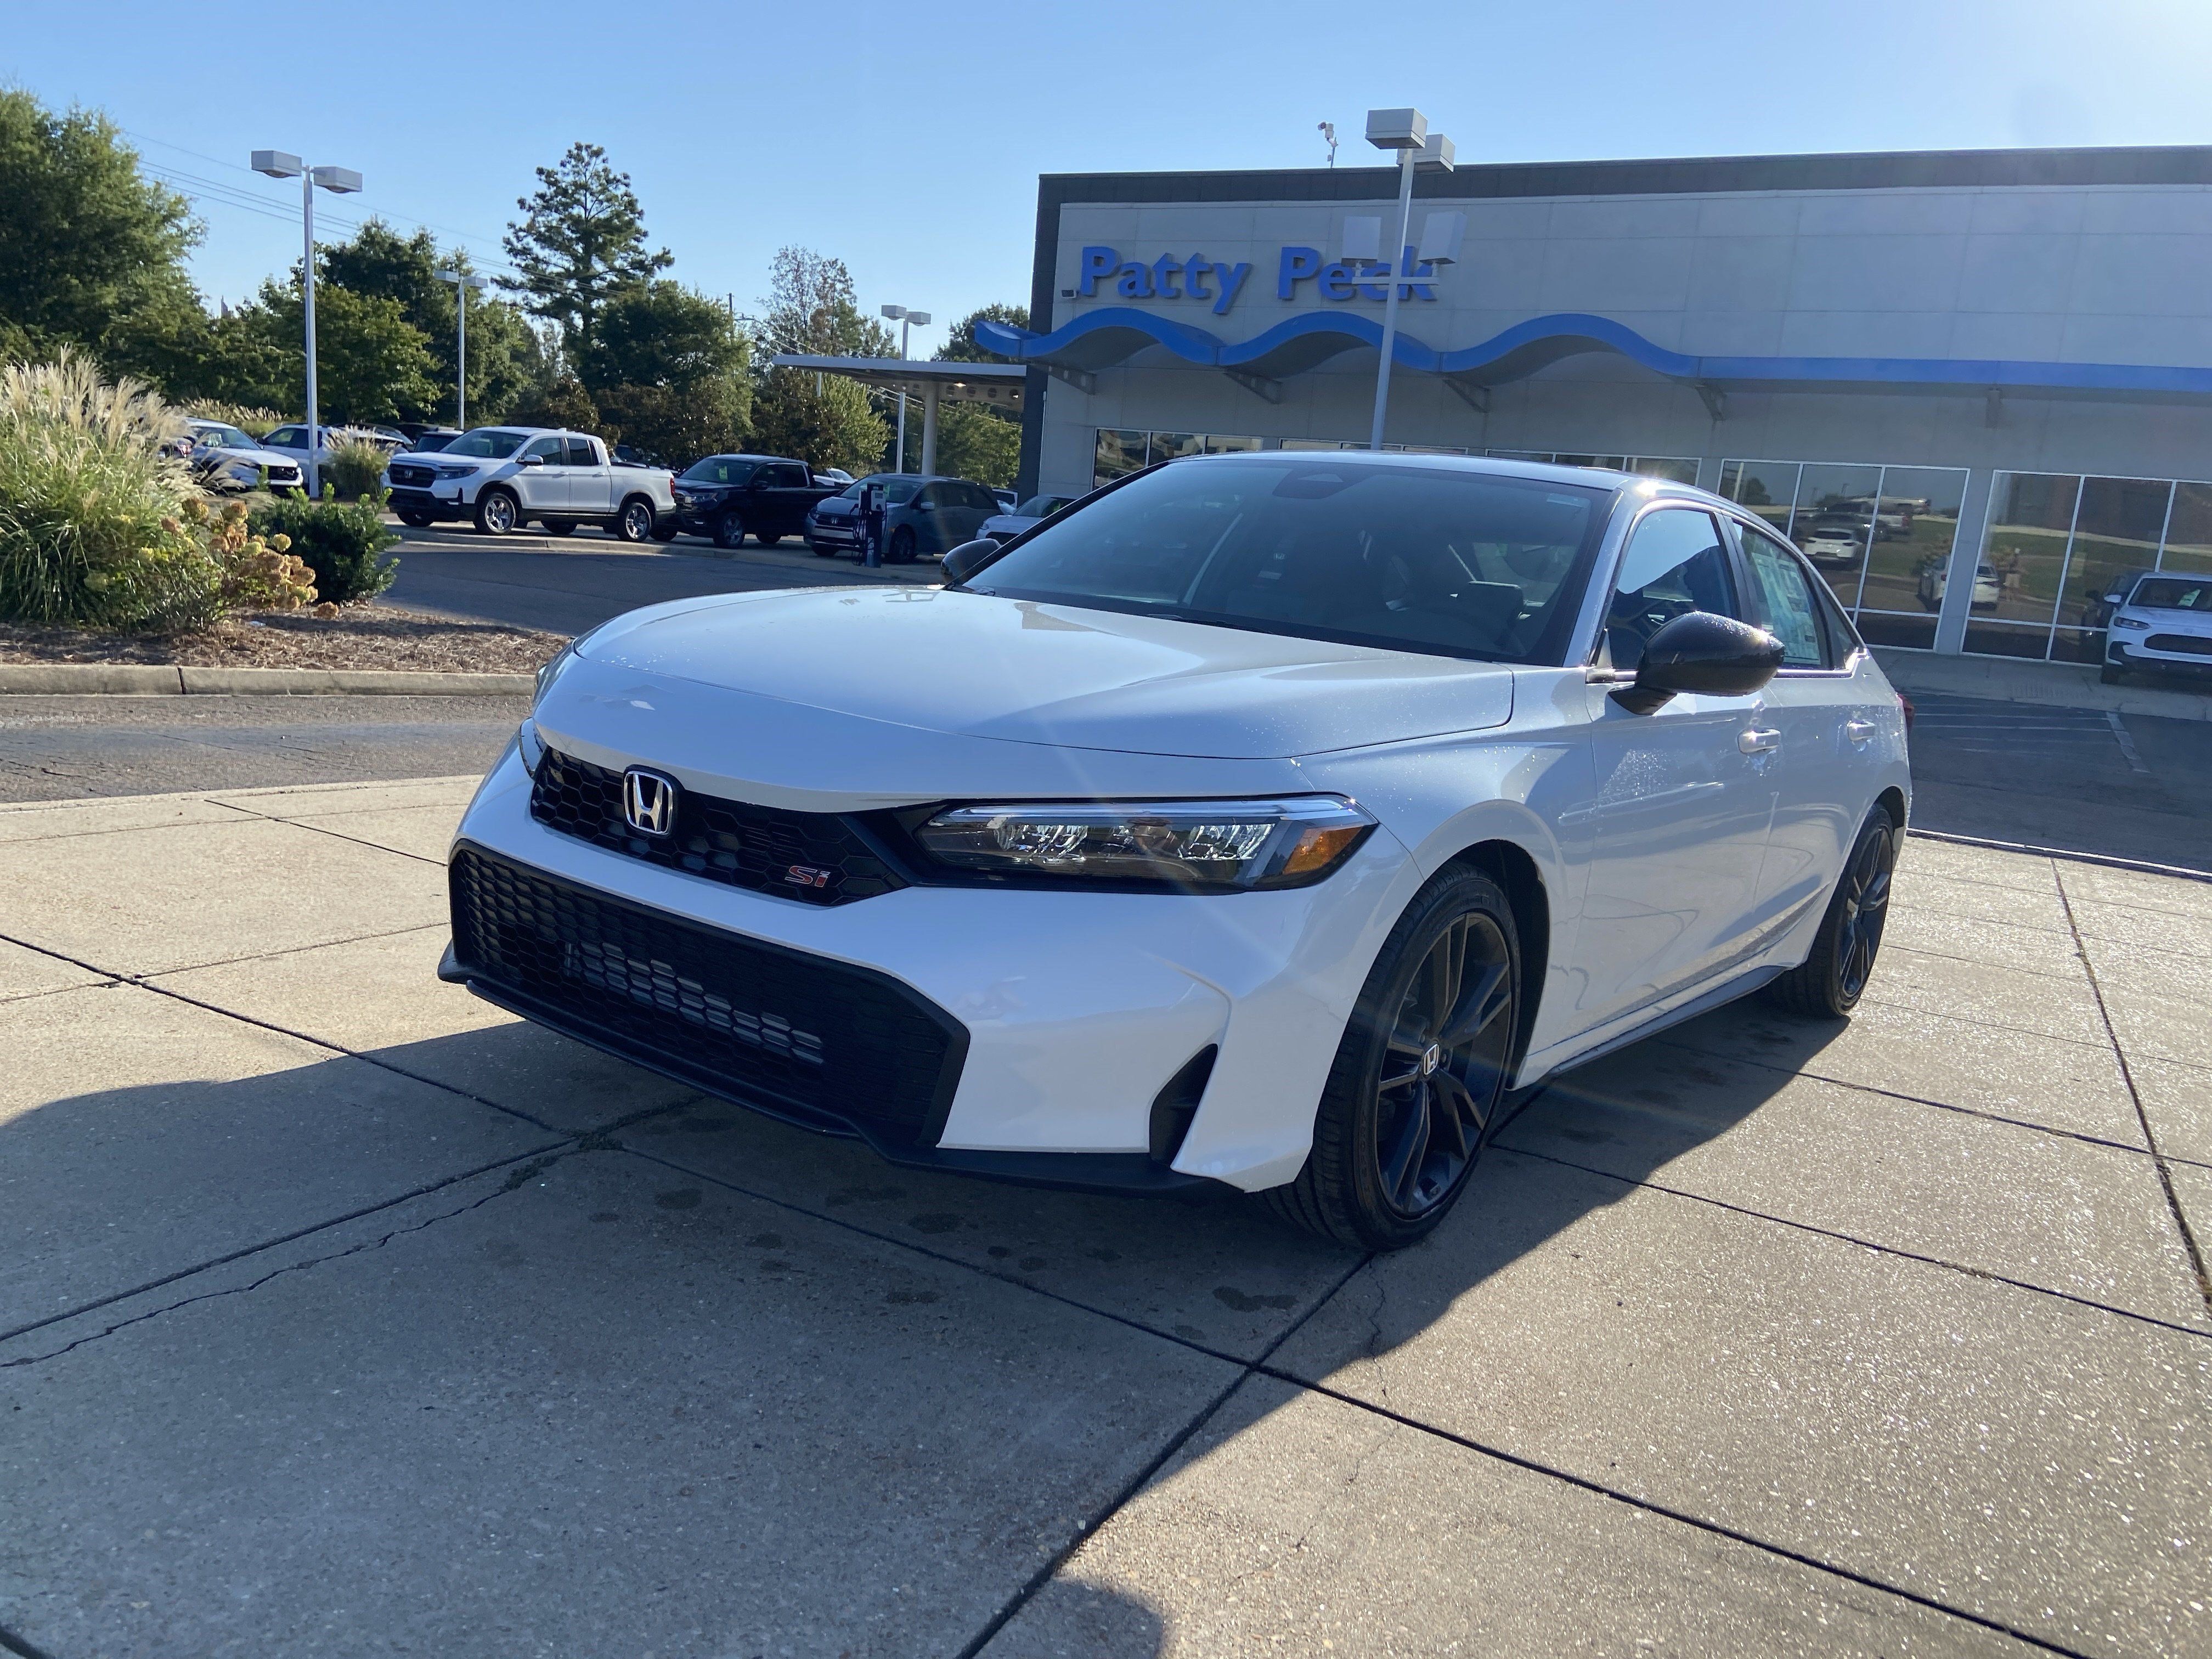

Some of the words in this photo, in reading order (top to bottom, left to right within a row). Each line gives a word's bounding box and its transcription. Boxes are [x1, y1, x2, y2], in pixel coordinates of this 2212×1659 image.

[1080, 246, 1254, 314] Patty
[1277, 245, 1438, 301] Peck
[785, 865, 831, 888] Si
